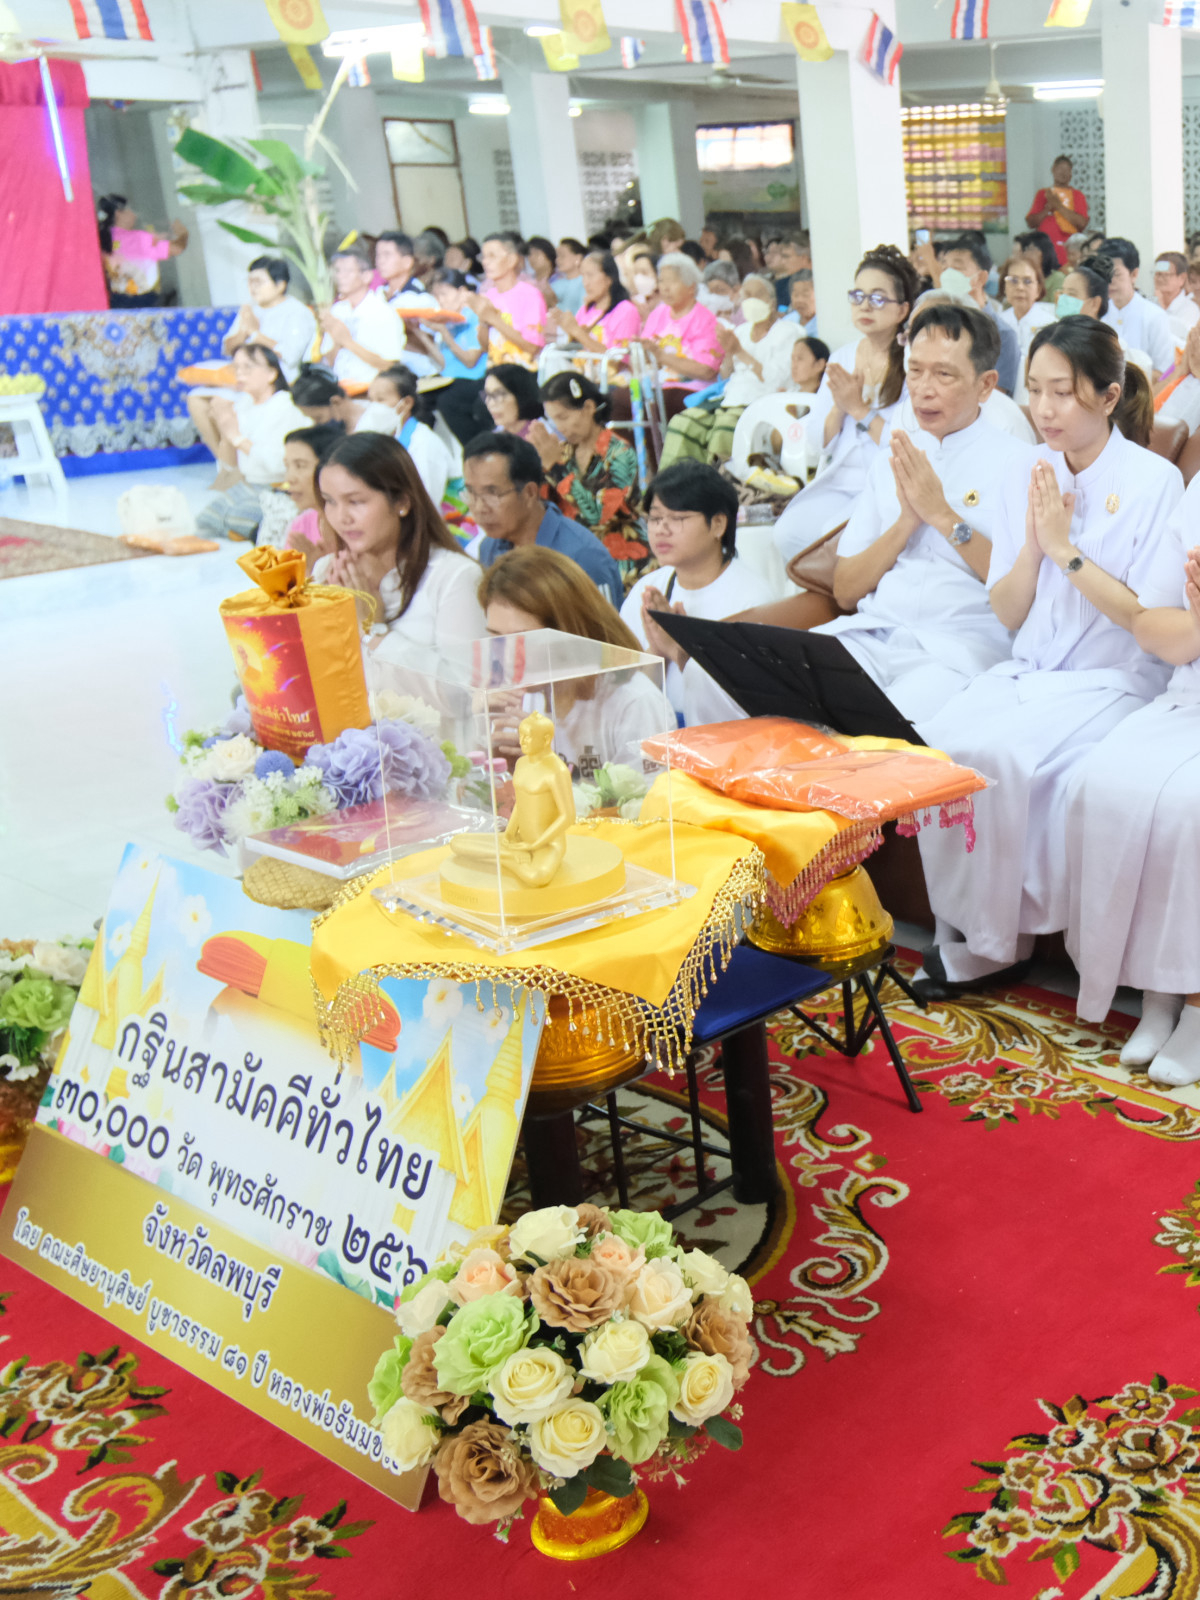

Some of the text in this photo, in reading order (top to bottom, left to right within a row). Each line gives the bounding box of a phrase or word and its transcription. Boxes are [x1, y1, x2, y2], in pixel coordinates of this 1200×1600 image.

[55, 1078, 170, 1160] ๓๐,๐๐๐
[177, 1132, 203, 1180] วัด
[207, 1160, 332, 1247] พุทธศักราช
[117, 1011, 433, 1200] กฐินสามัคคีทั่วไทย
[15, 1210, 41, 1247] โดย
[41, 1236, 152, 1312] คณะศิษยานุศิษย์
[149, 1299, 221, 1358] บูชาธรรม
[253, 1352, 268, 1384] ปี
[145, 1203, 282, 1319] จังหวัดลพบุรี
